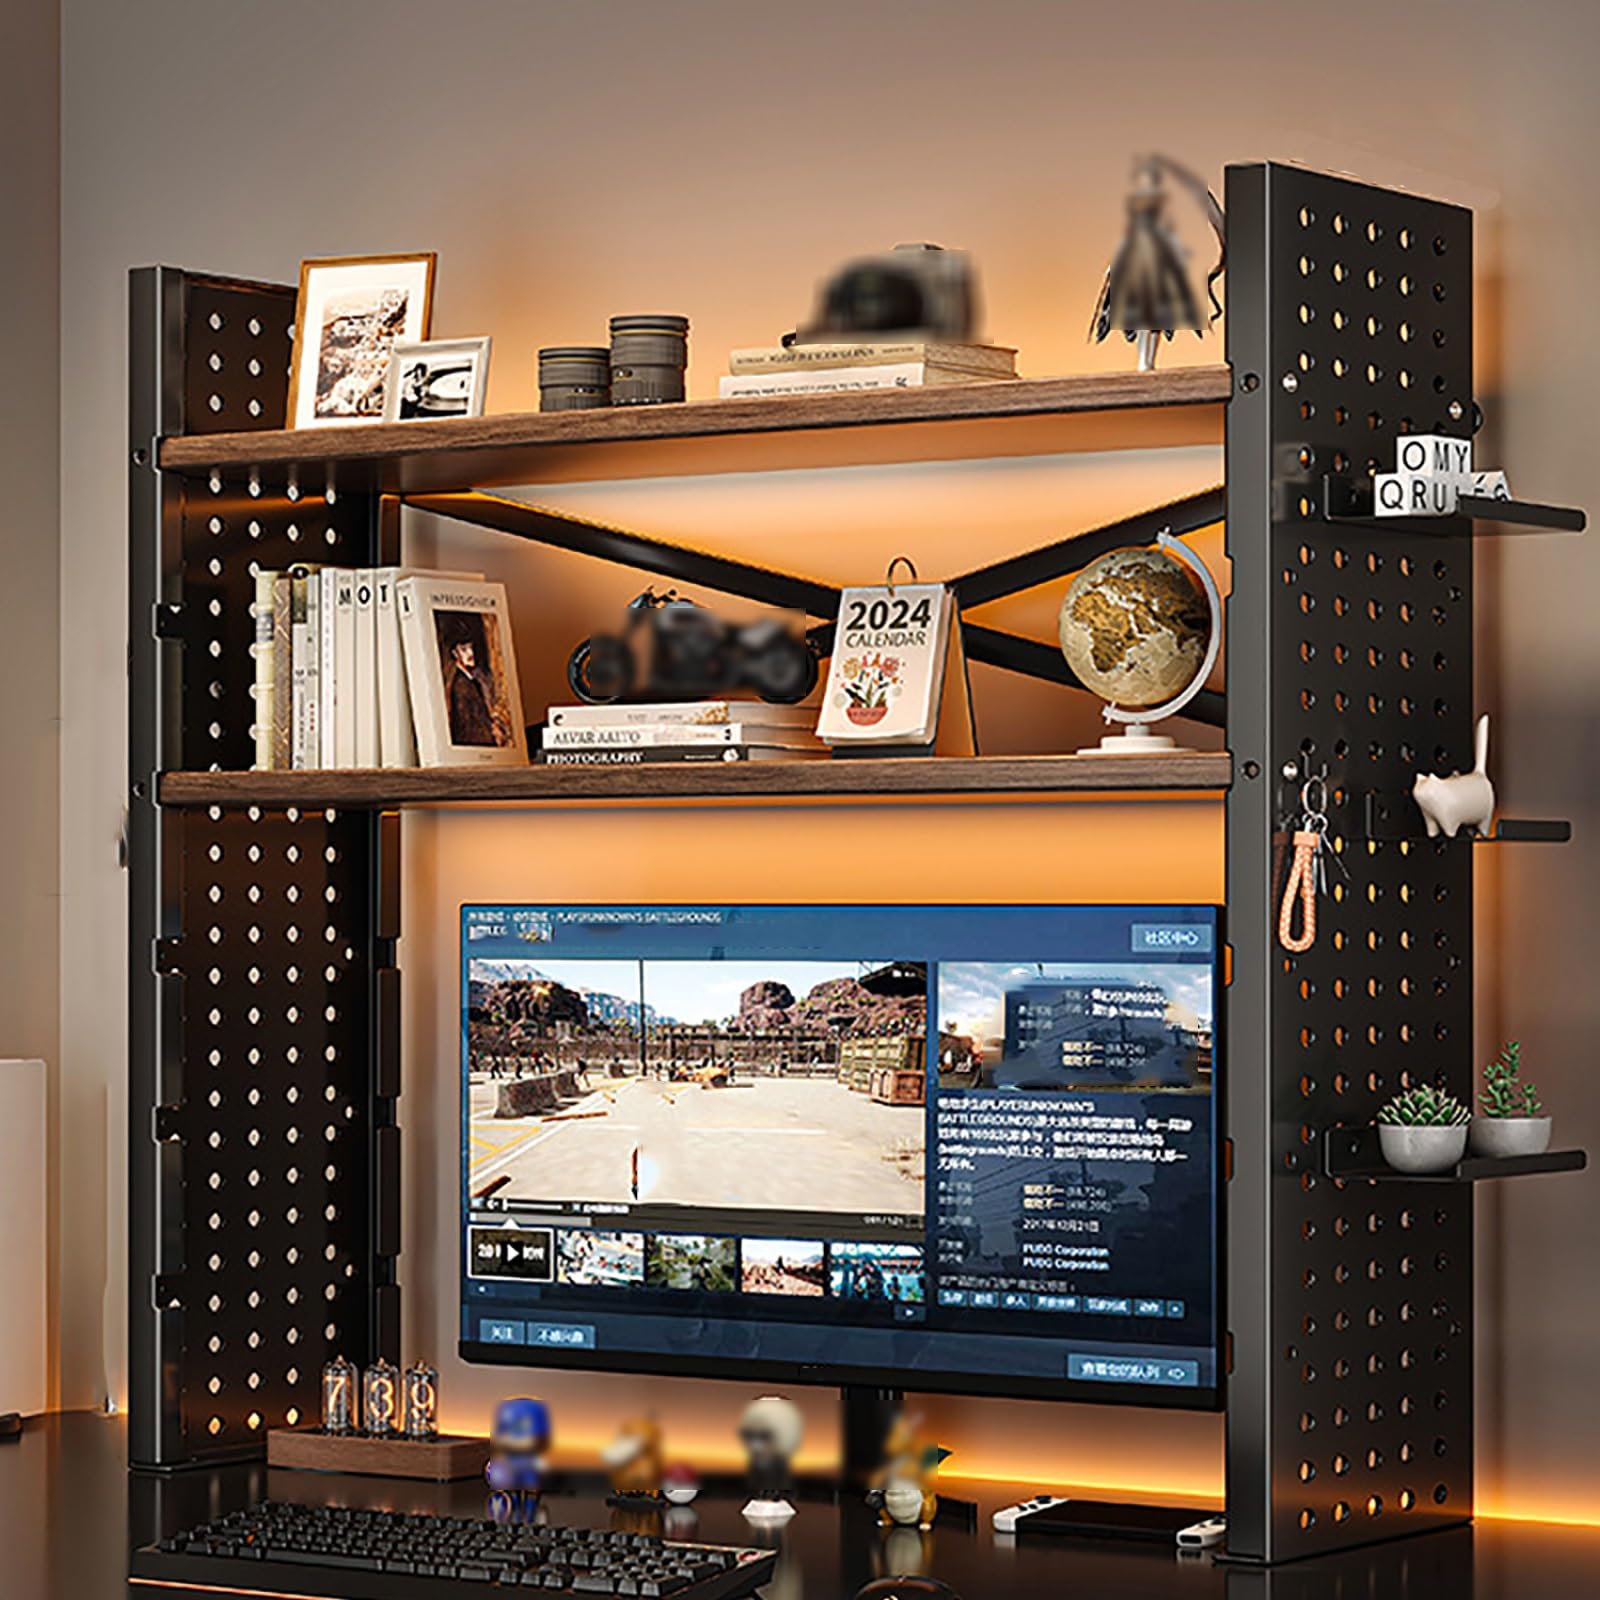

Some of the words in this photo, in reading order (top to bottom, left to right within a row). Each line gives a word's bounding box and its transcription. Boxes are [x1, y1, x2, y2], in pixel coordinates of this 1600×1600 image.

[846, 598, 931, 631] 2024
[845, 631, 926, 649] CALENDAR
[546, 752, 643, 765] PHOTOGRAPHY
